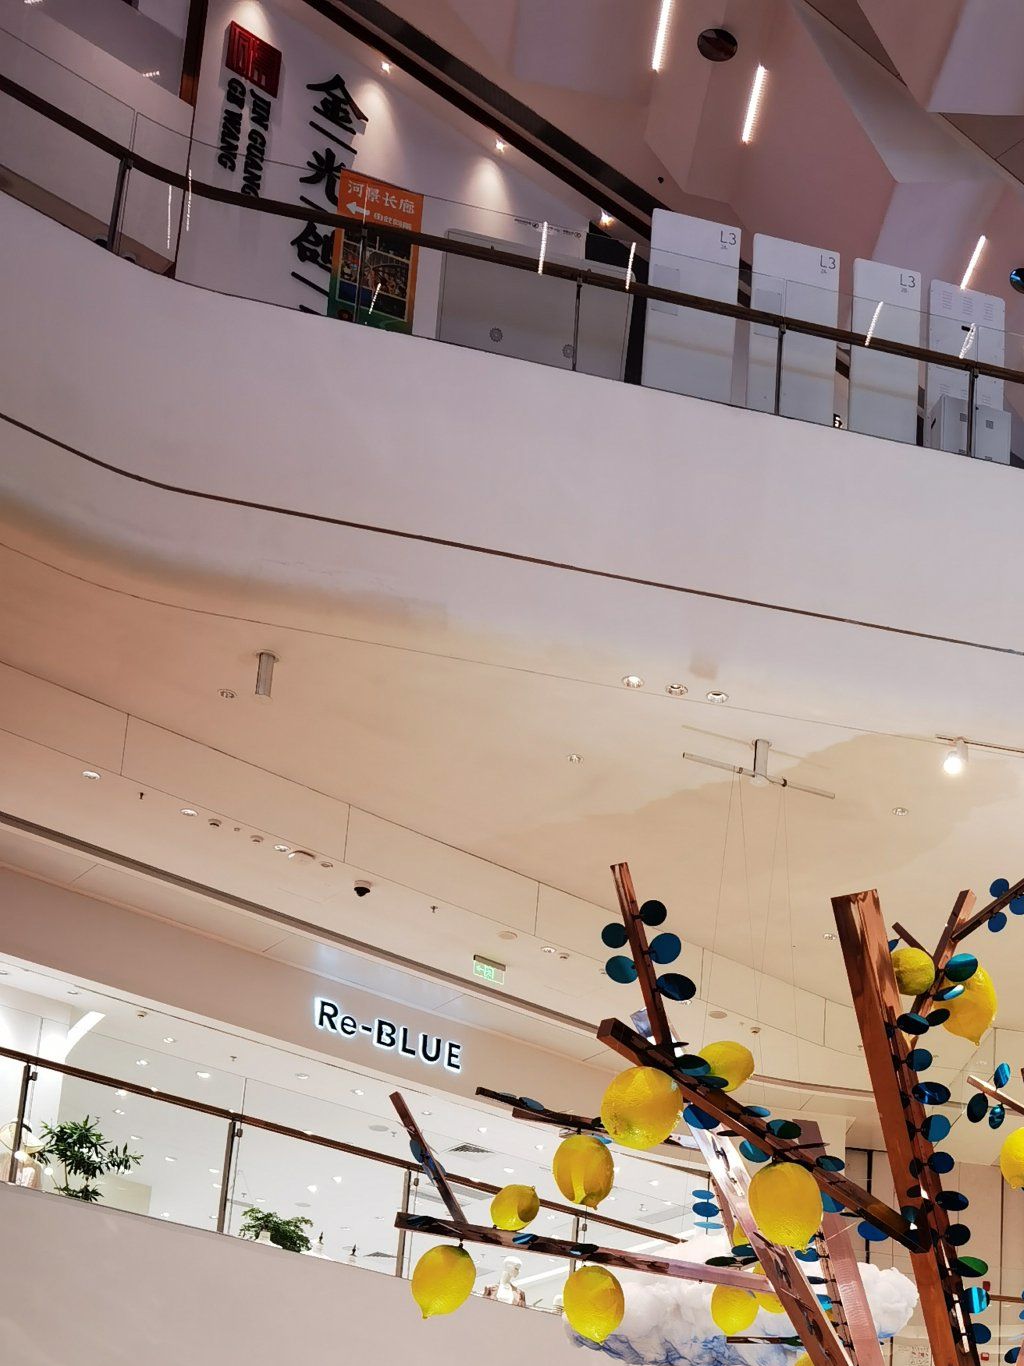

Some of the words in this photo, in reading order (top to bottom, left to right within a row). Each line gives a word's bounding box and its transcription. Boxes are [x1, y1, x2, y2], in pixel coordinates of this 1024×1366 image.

[250, 88, 272, 132] JIN
[217, 108, 243, 172] WANG
[241, 128, 267, 198] GUANG
[720, 230, 737, 246] L3
[819, 254, 836, 270] L3
[900, 273, 916, 288] L3
[317, 999, 462, 1070] Re-BLUE
